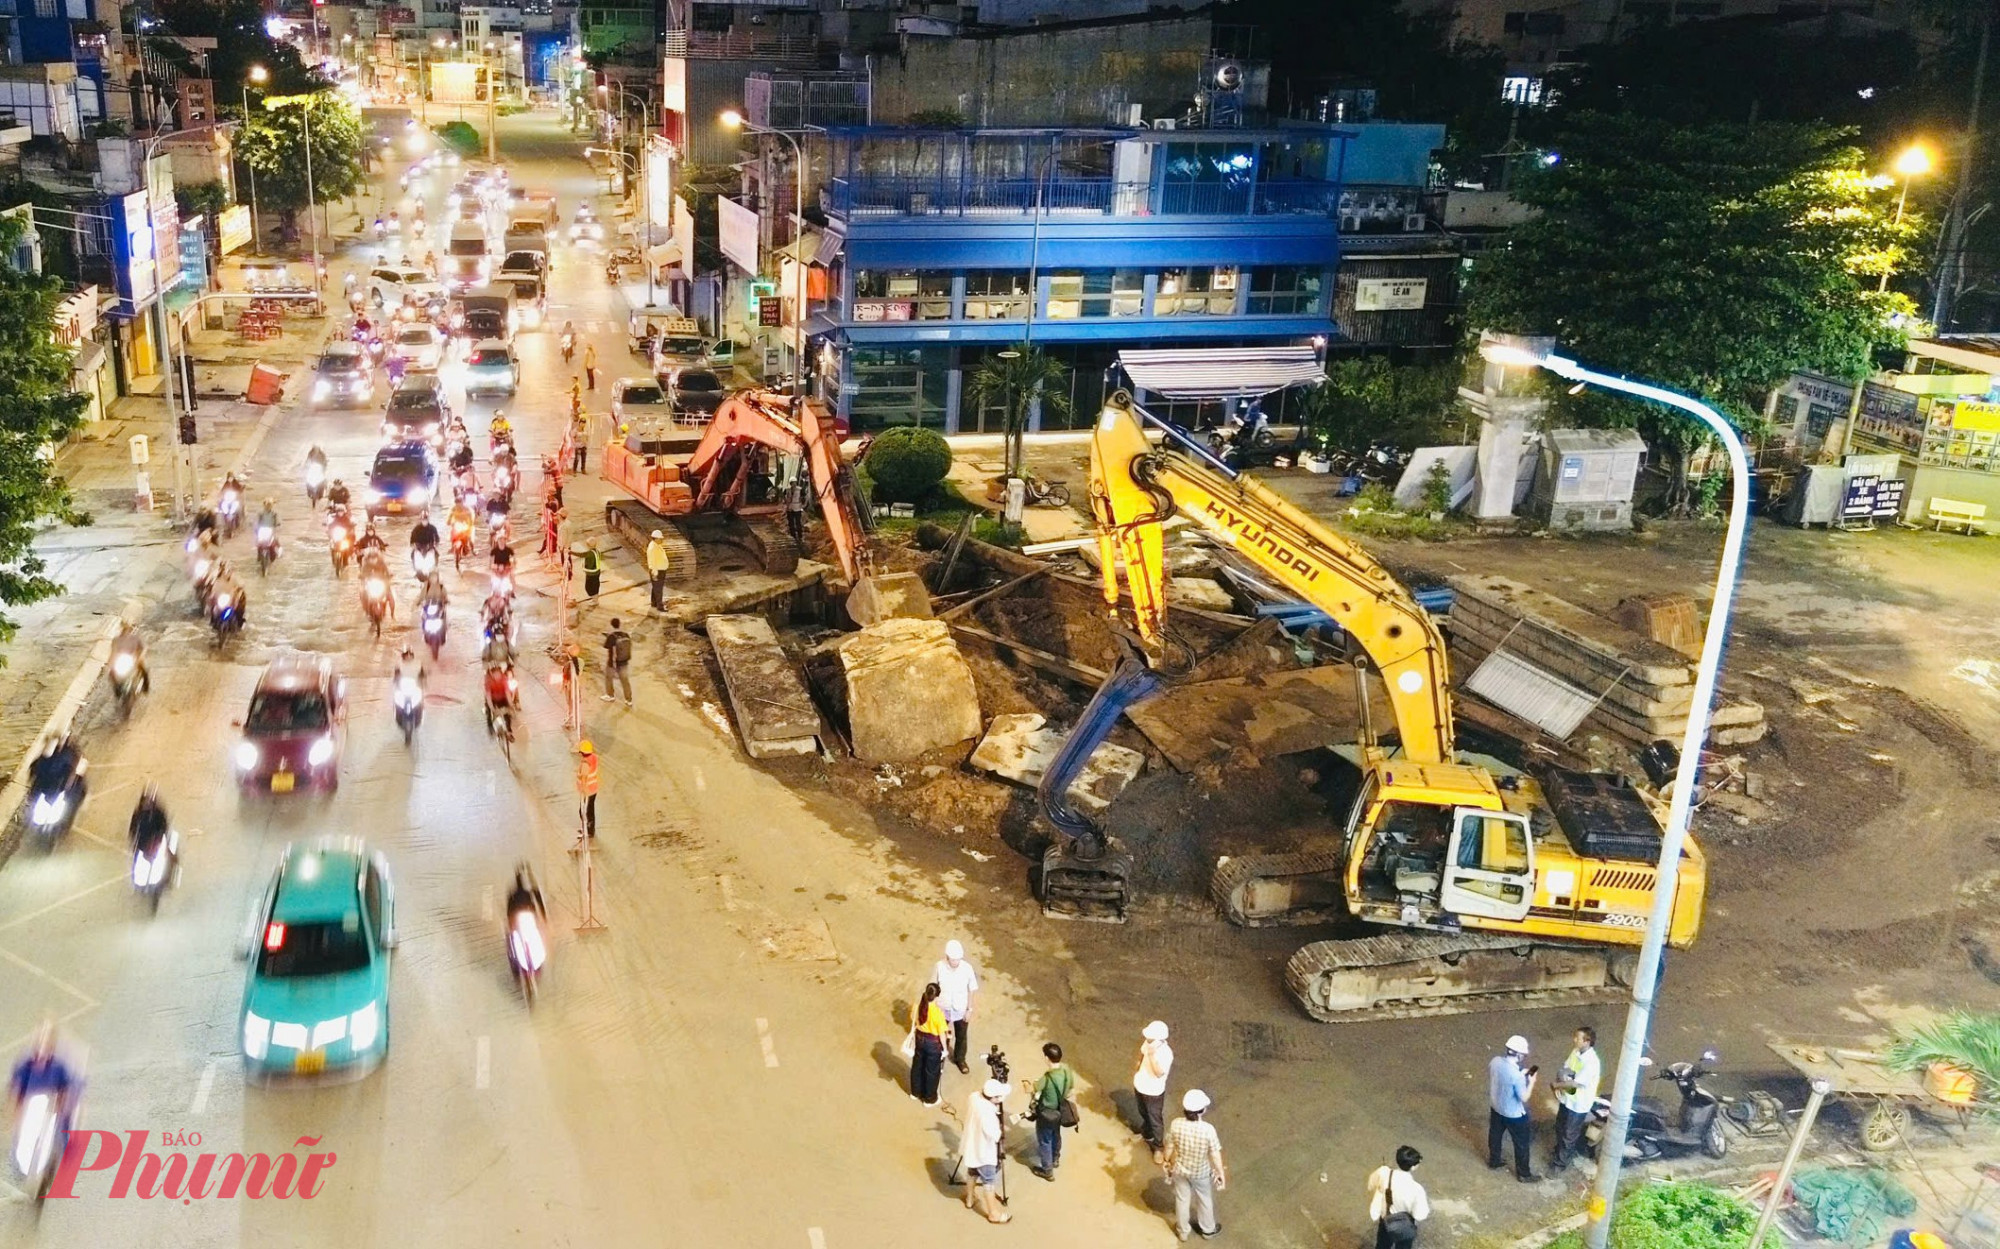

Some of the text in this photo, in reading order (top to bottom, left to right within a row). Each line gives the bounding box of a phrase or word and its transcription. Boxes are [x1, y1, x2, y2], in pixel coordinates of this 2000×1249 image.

[1402, 287, 1410, 296] AN
[1858, 487, 1869, 495] XE
[1890, 491, 1901, 500] XE
[1205, 501, 1320, 583] HYUNDAI
